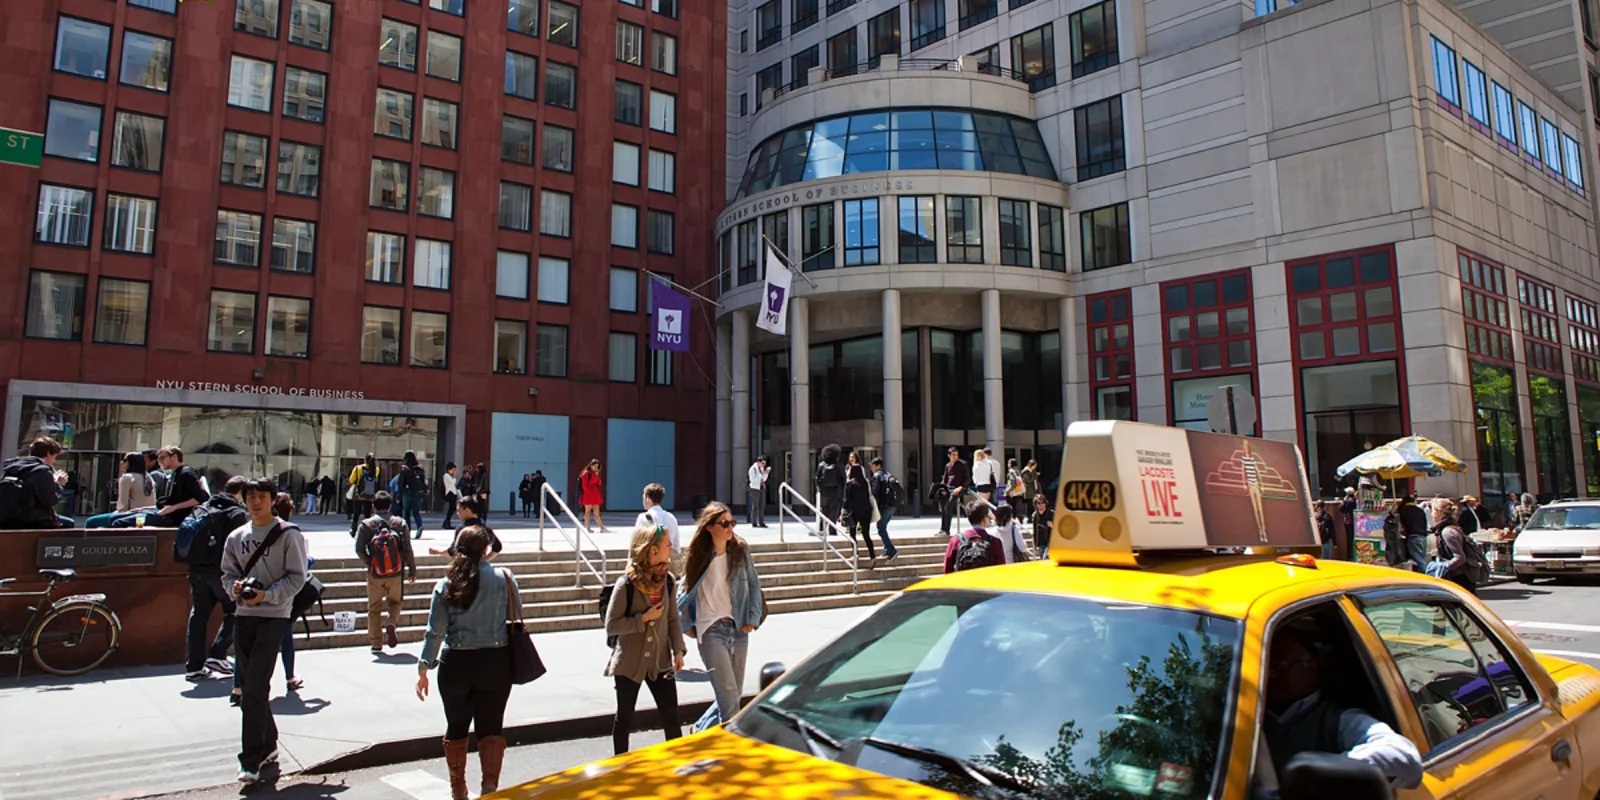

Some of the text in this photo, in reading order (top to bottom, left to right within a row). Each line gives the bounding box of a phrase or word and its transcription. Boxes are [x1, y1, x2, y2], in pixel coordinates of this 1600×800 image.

[7, 134, 30, 149] ST
[752, 192, 799, 213] SCHOOL
[806, 188, 823, 200] OF
[829, 180, 913, 197] BUSINESS
[766, 312, 779, 324] NYU
[657, 333, 681, 344] NYU
[156, 379, 365, 400] NYU STERN SCHOOL OF BUSINESS
[1138, 465, 1176, 480] LACOSTE
[1067, 483, 1111, 509] 4K48
[82, 545, 148, 555] GOULD PLAZA
